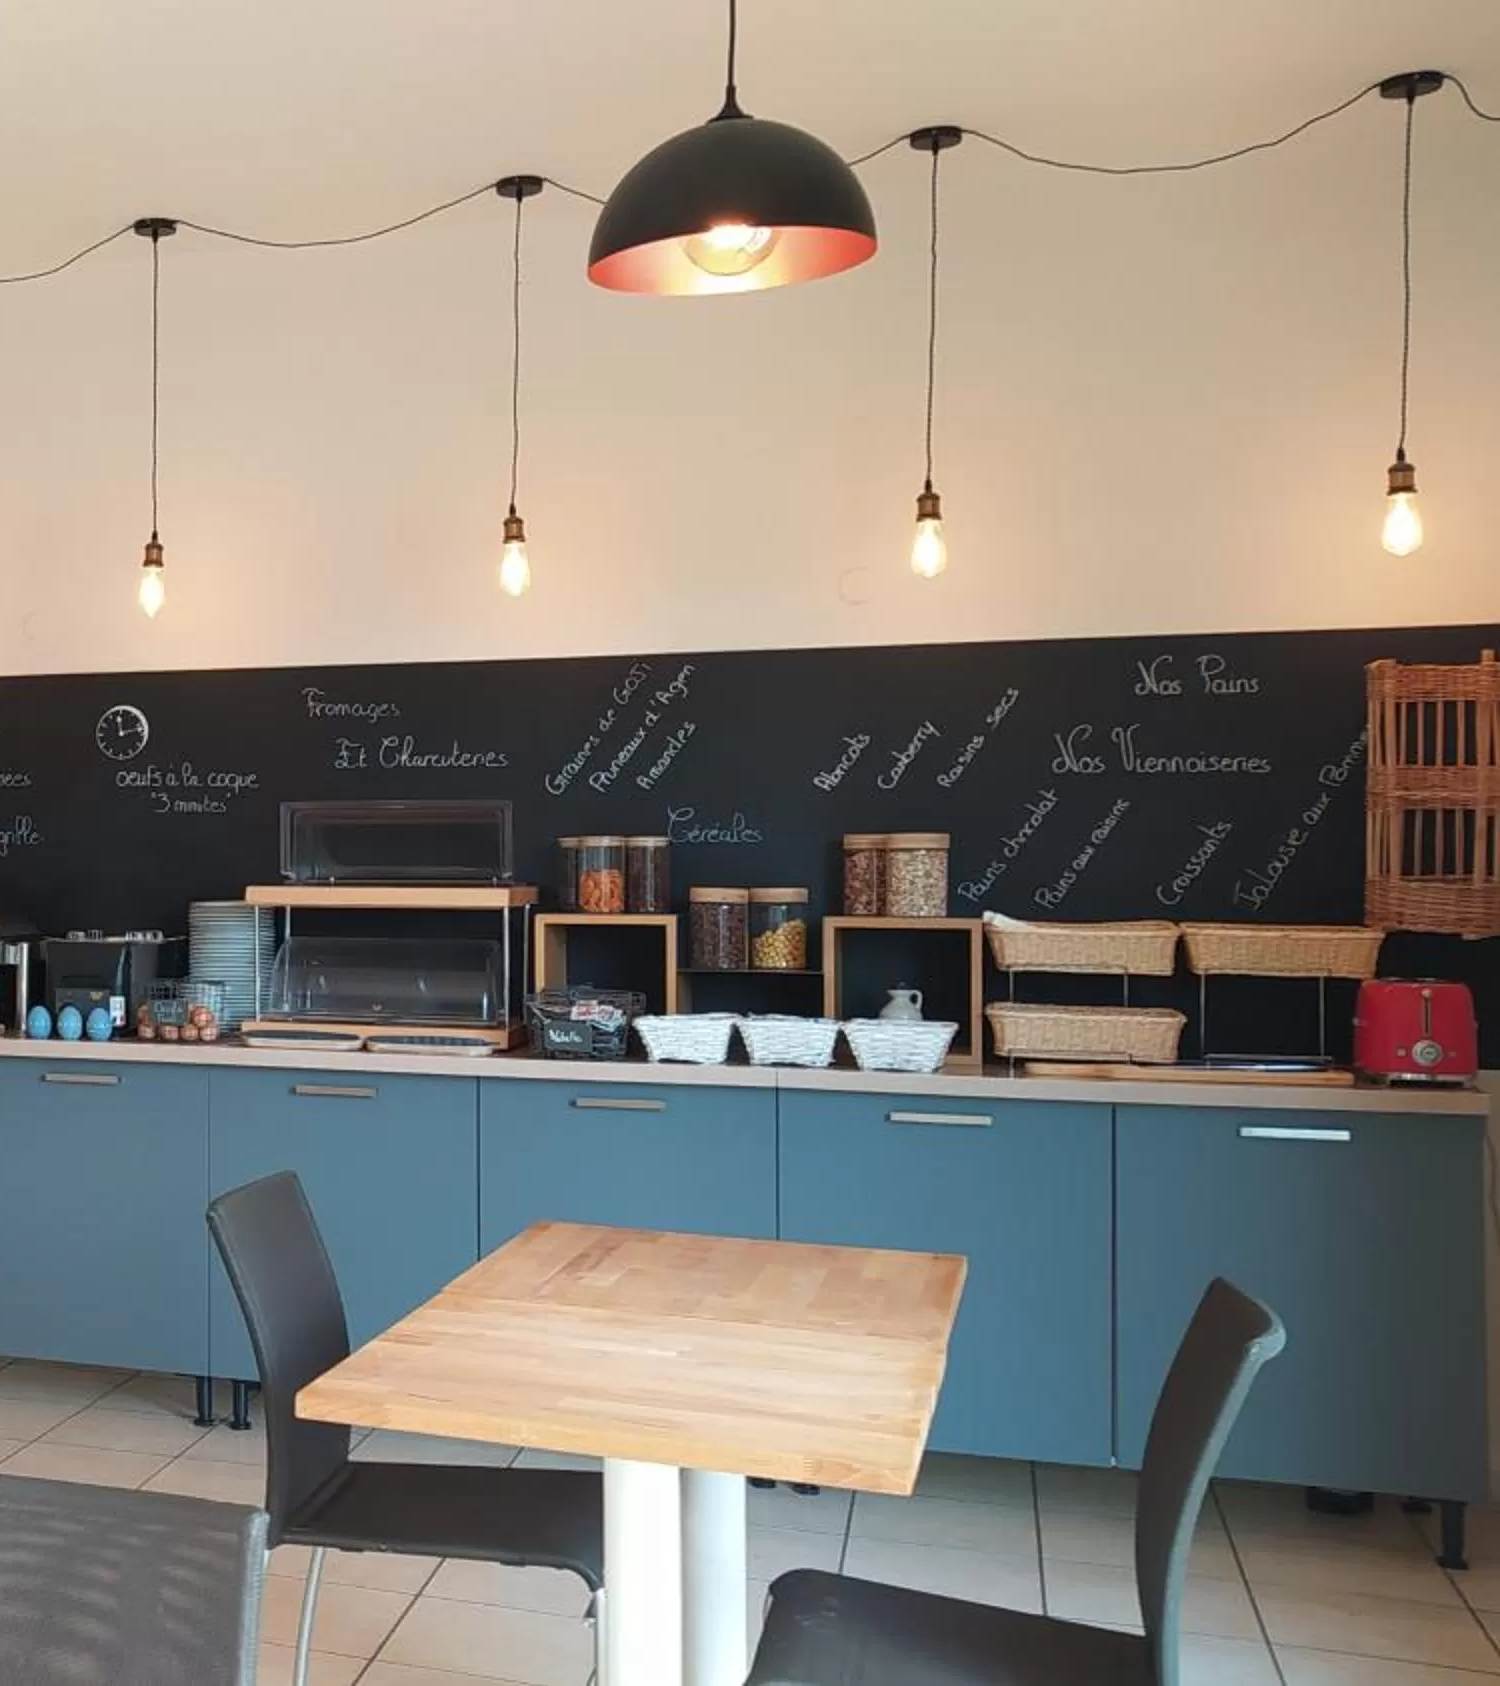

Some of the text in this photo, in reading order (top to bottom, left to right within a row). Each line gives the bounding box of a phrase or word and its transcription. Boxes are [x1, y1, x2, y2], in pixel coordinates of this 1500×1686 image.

[1134, 654, 1260, 696] Nos Pains
[301, 687, 401, 724] Fromages
[545, 735, 600, 795] Graines
[599, 708, 617, 732] de
[588, 727, 647, 793] Pruneaux
[636, 720, 696, 790] Amandes
[1051, 723, 1272, 773] Nos Viennoiseries
[181, 761, 203, 786] la
[207, 771, 260, 795] coque
[667, 804, 763, 844] Céréales
[1302, 792, 1332, 825] aux
[957, 860, 1007, 902] Pains
[1156, 821, 1232, 905] Croissants
[1034, 870, 1077, 909] Pains
